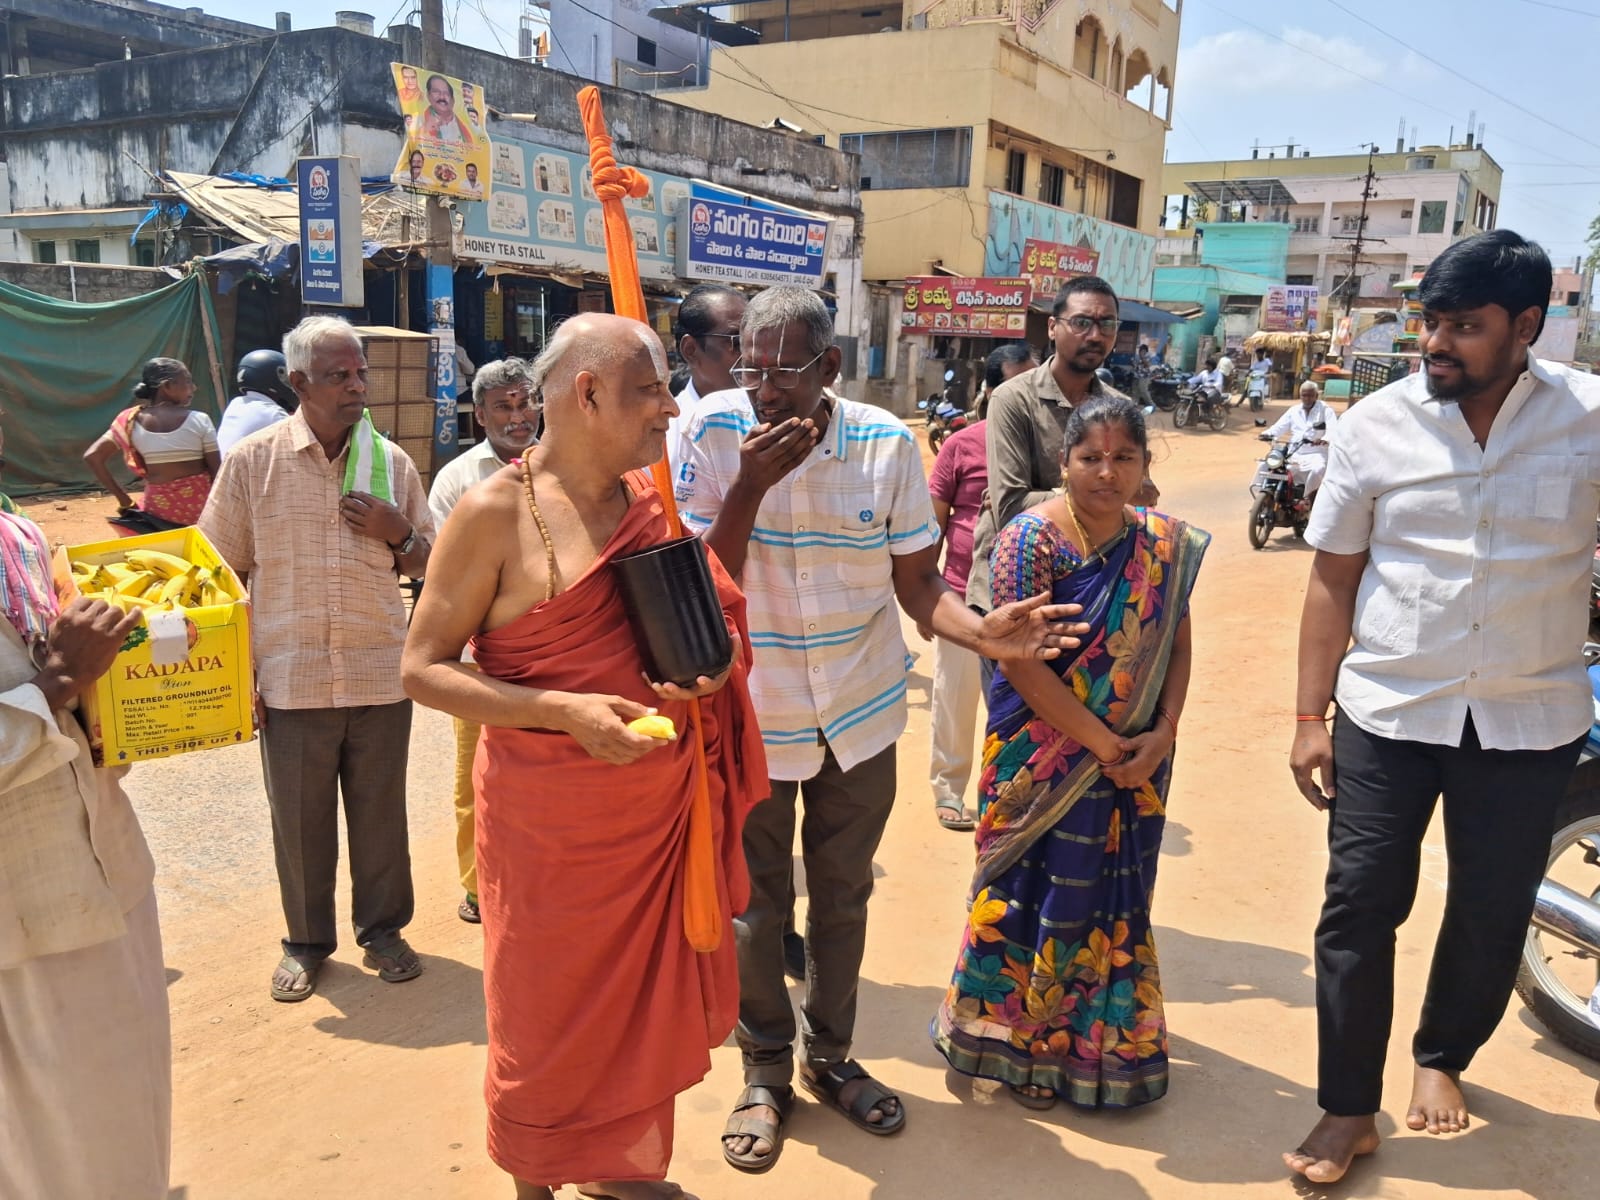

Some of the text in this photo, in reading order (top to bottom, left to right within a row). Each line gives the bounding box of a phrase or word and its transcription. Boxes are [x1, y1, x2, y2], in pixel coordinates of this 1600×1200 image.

[714, 209, 759, 239] సంగం
[464, 239, 546, 260] HONEY TEA STALL
[706, 241, 733, 257] పాలు
[734, 244, 743, 258] &
[745, 246, 766, 261] పాల
[695, 263, 713, 275] HONEY
[715, 266, 725, 276] TEA
[726, 267, 743, 278] STALL
[904, 286, 920, 310] శ్రీ
[922, 285, 953, 310] అమ్మ
[986, 291, 1023, 306] సెంటర్
[125, 655, 225, 680] KADAPA
[121, 695, 163, 706] FILTERED
[165, 688, 218, 701] GROUNDNUT
[220, 684, 232, 692] OIL
[136, 745, 169, 756] THIS
[174, 739, 205, 750] SIDE
[210, 736, 228, 745] UP
